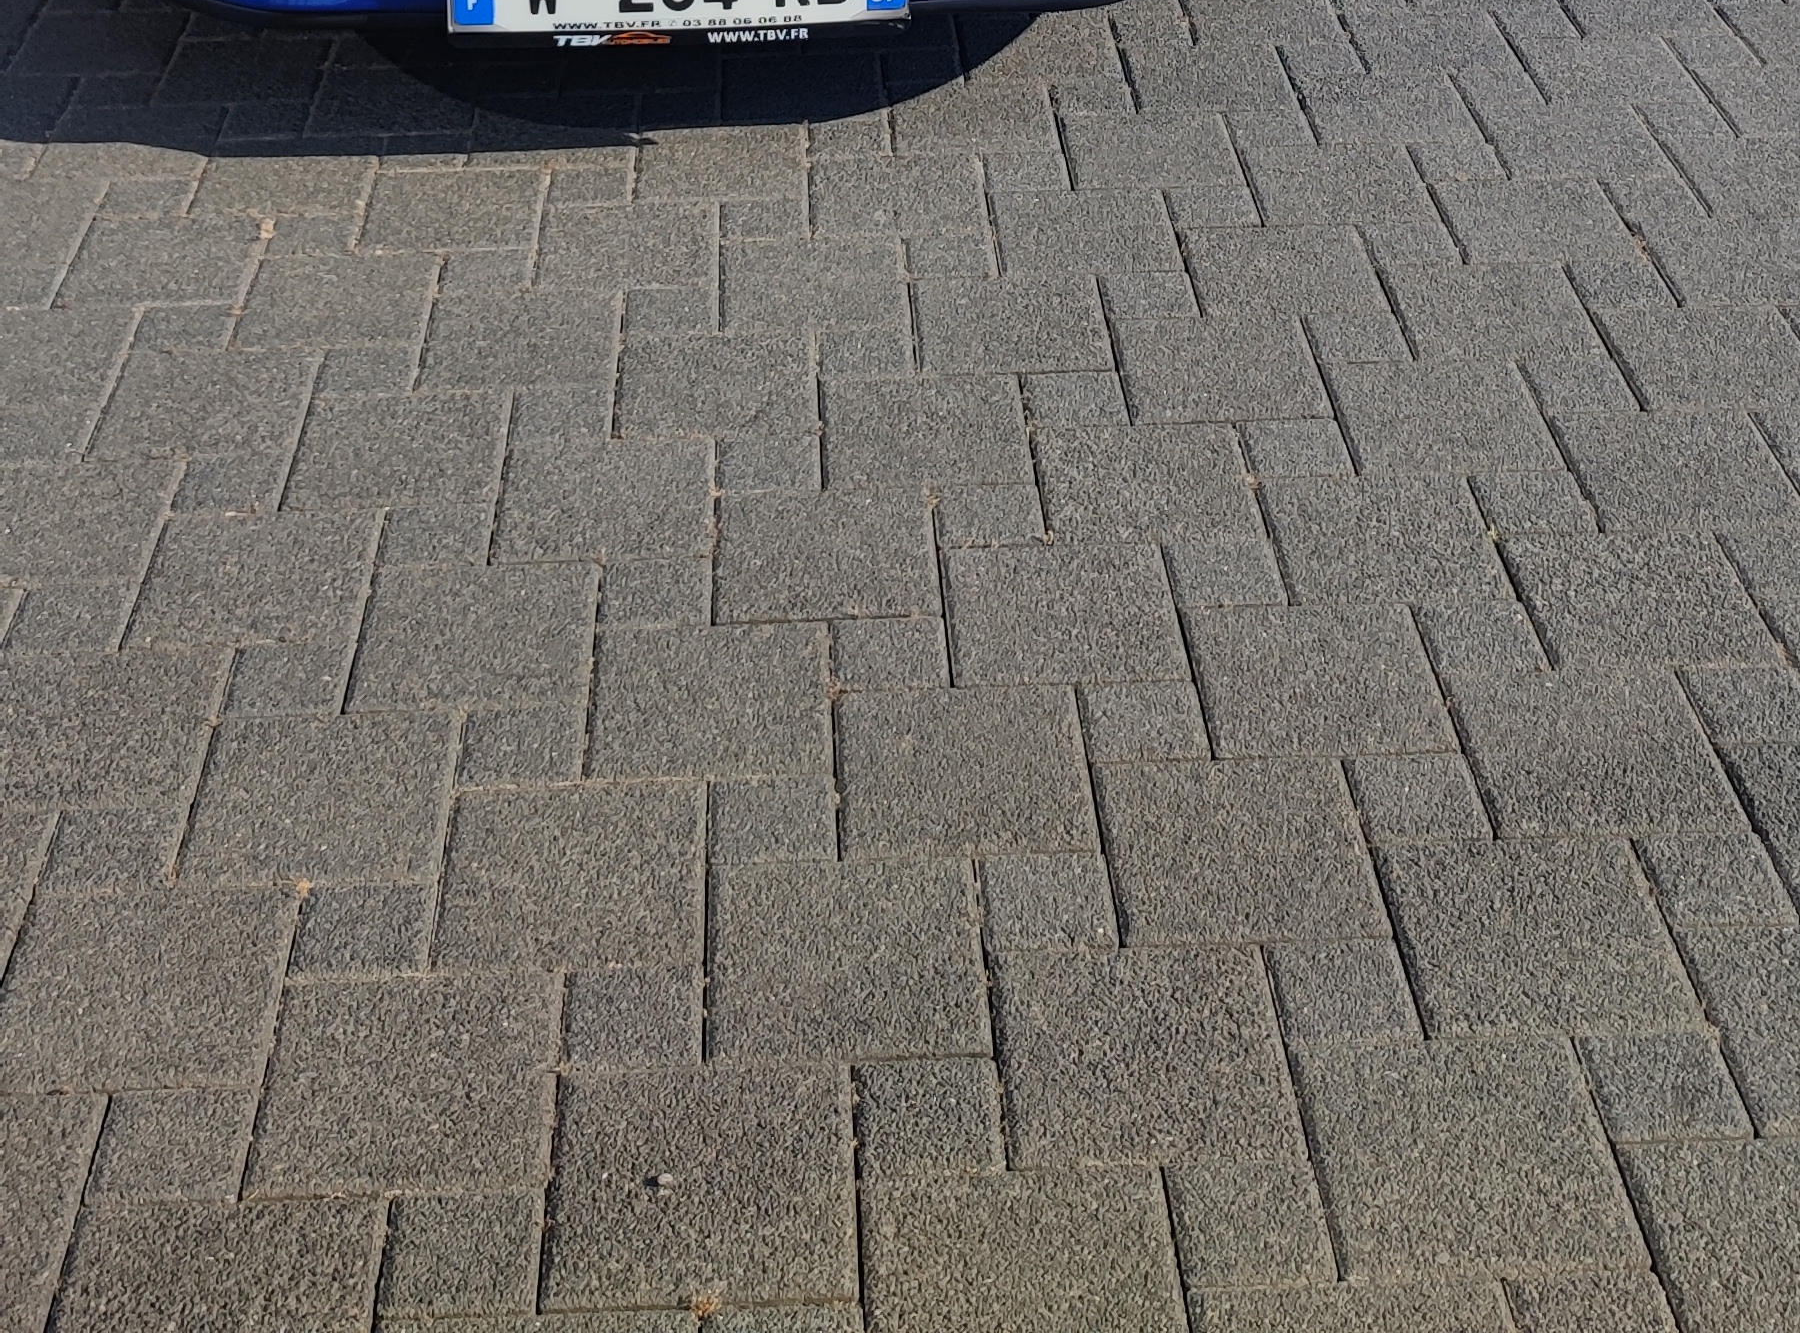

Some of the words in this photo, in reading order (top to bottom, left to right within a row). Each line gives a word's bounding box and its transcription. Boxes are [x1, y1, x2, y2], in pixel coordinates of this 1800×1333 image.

[552, 20, 662, 30] WWW.TBV.FR
[682, 19, 702, 27] 03
[707, 18, 727, 27] 88
[732, 17, 752, 26] 06
[757, 16, 778, 24] 06
[783, 14, 803, 23] 88
[553, 34, 612, 47] TBV
[707, 28, 809, 44] WWW.TBV.FR
